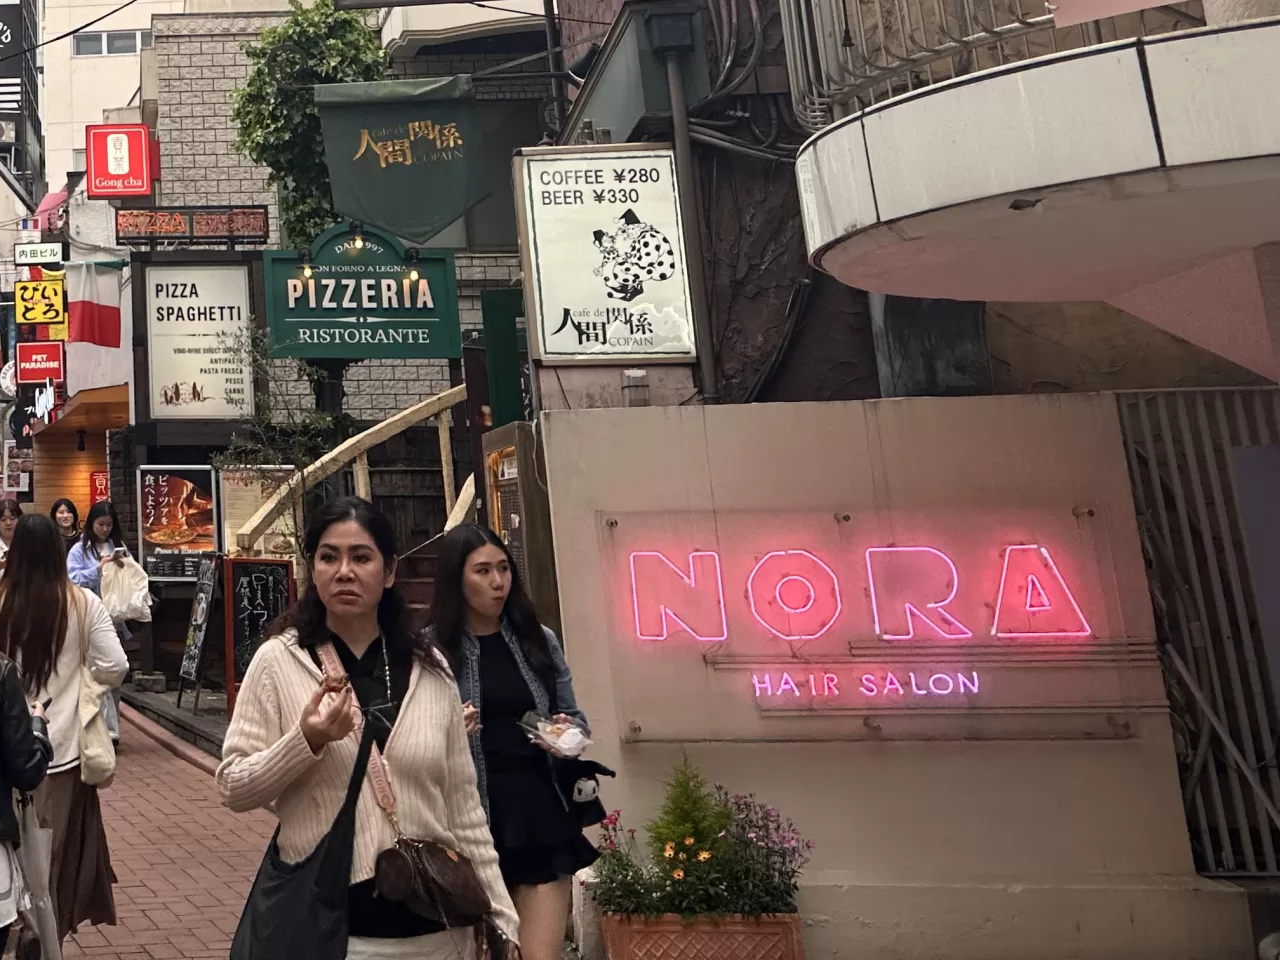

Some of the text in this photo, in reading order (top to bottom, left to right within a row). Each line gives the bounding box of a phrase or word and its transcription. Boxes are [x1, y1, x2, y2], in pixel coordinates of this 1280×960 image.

[352, 119, 463, 169] 人間関係
[95, 176, 143, 189] Gong cha
[539, 168, 660, 186] COFFEE ¥280
[541, 189, 639, 206] BEER ¥330
[117, 211, 186, 233] PIZZA
[19, 248, 58, 259] 内田ビル
[332, 265, 365, 273] FORNO
[367, 265, 375, 273] A
[155, 283, 199, 299] PIZZA
[287, 278, 435, 309] PIZZERIA
[156, 305, 241, 322] SPAGHETTI
[593, 307, 605, 318] de
[550, 307, 655, 346] 人間関係
[297, 329, 430, 344] RISTORANTE
[607, 336, 654, 347] COPAIN
[20, 361, 60, 369] PARADISE
[32, 354, 48, 362] PET
[225, 377, 244, 385] PESCE
[629, 543, 1092, 641] NORA
[752, 671, 980, 698] HAIR SALON
